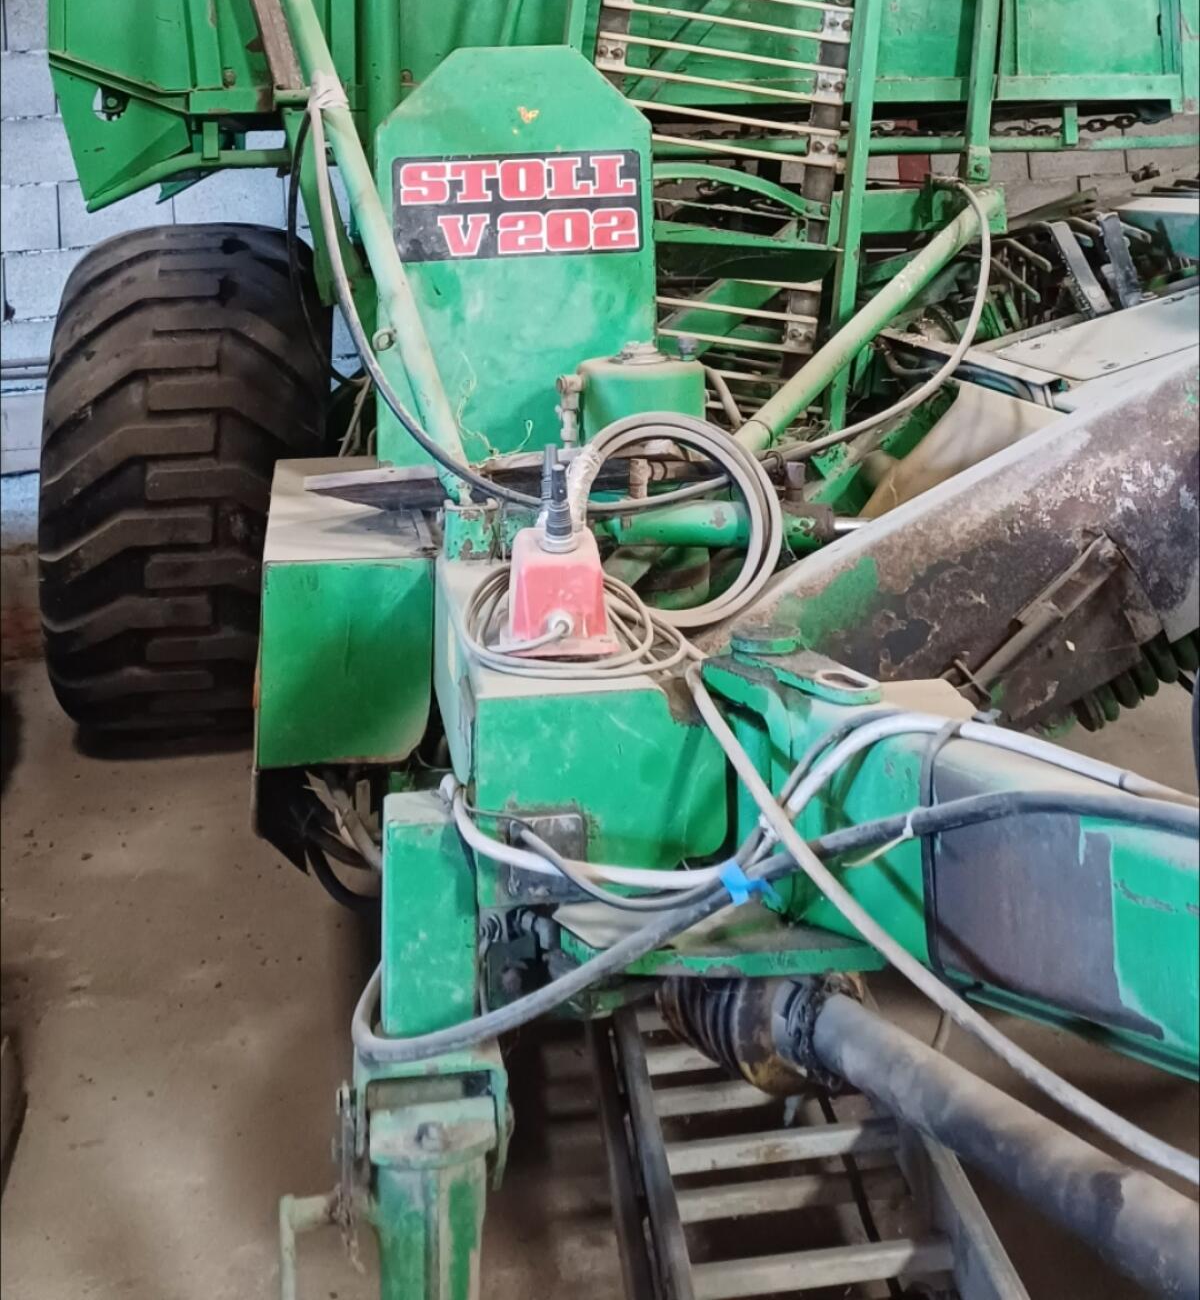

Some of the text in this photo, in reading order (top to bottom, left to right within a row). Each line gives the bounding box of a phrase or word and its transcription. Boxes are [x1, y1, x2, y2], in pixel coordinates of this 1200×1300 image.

[400, 155, 636, 205] STOLL
[438, 208, 639, 256] V 202
